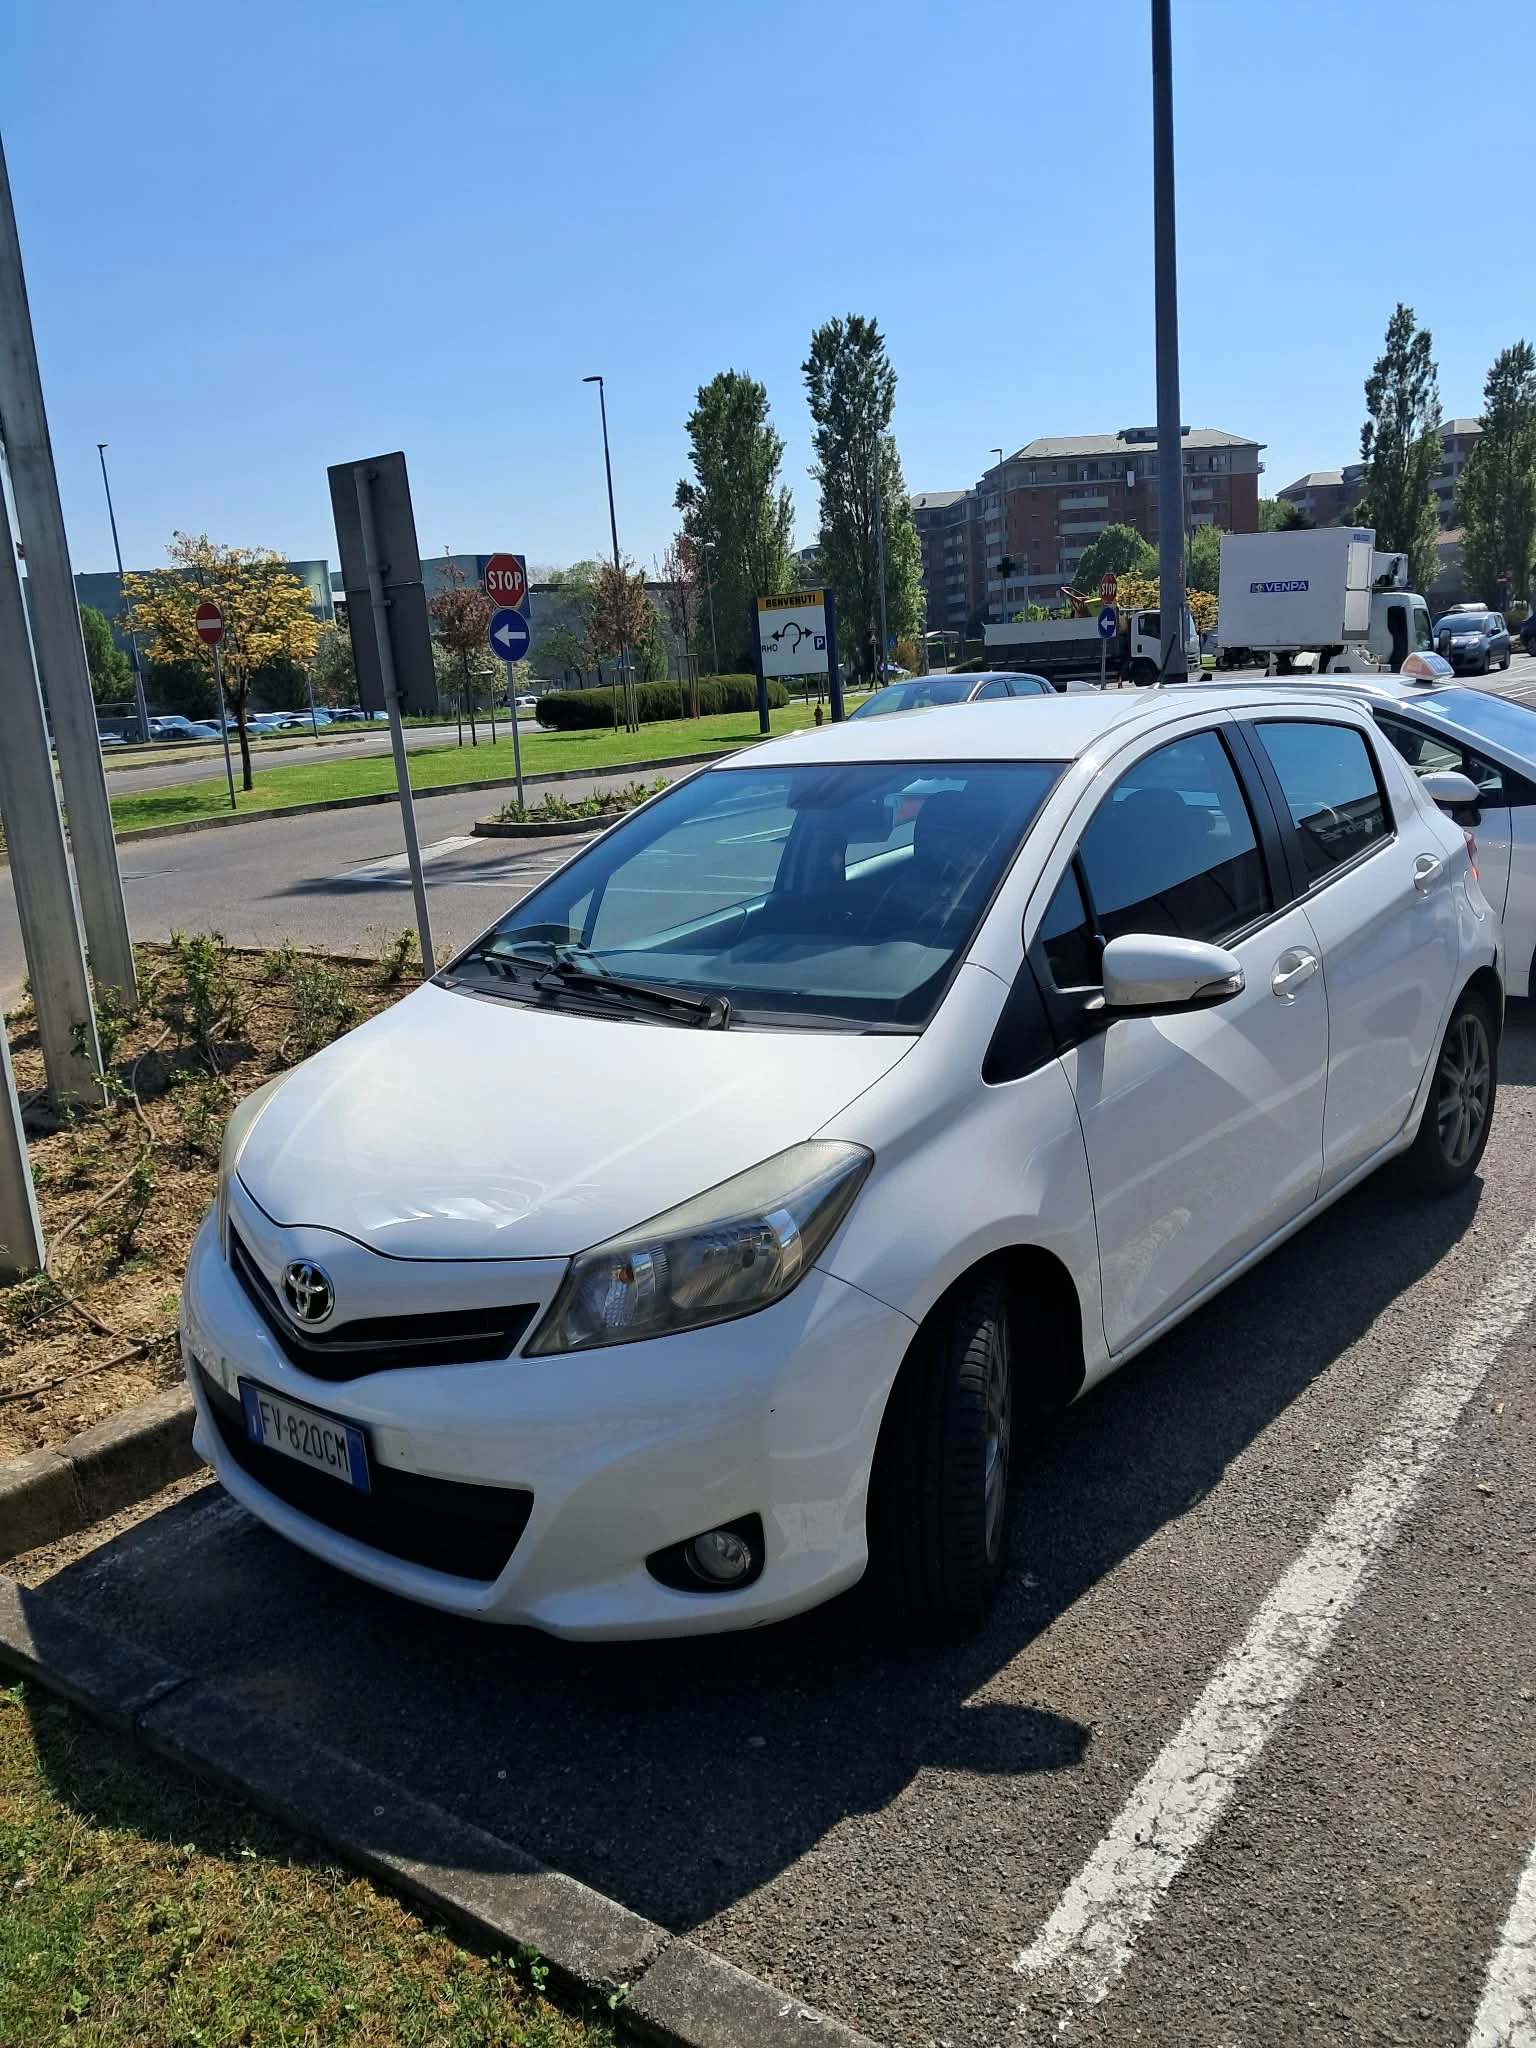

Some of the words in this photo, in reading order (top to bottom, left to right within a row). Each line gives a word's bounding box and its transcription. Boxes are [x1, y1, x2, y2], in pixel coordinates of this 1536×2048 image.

[488, 570, 522, 590] STOP
[1101, 583, 1116, 595] STOP
[1265, 582, 1307, 592] VENPA
[765, 593, 816, 608] BENVENUTI
[761, 643, 778, 653] RHO
